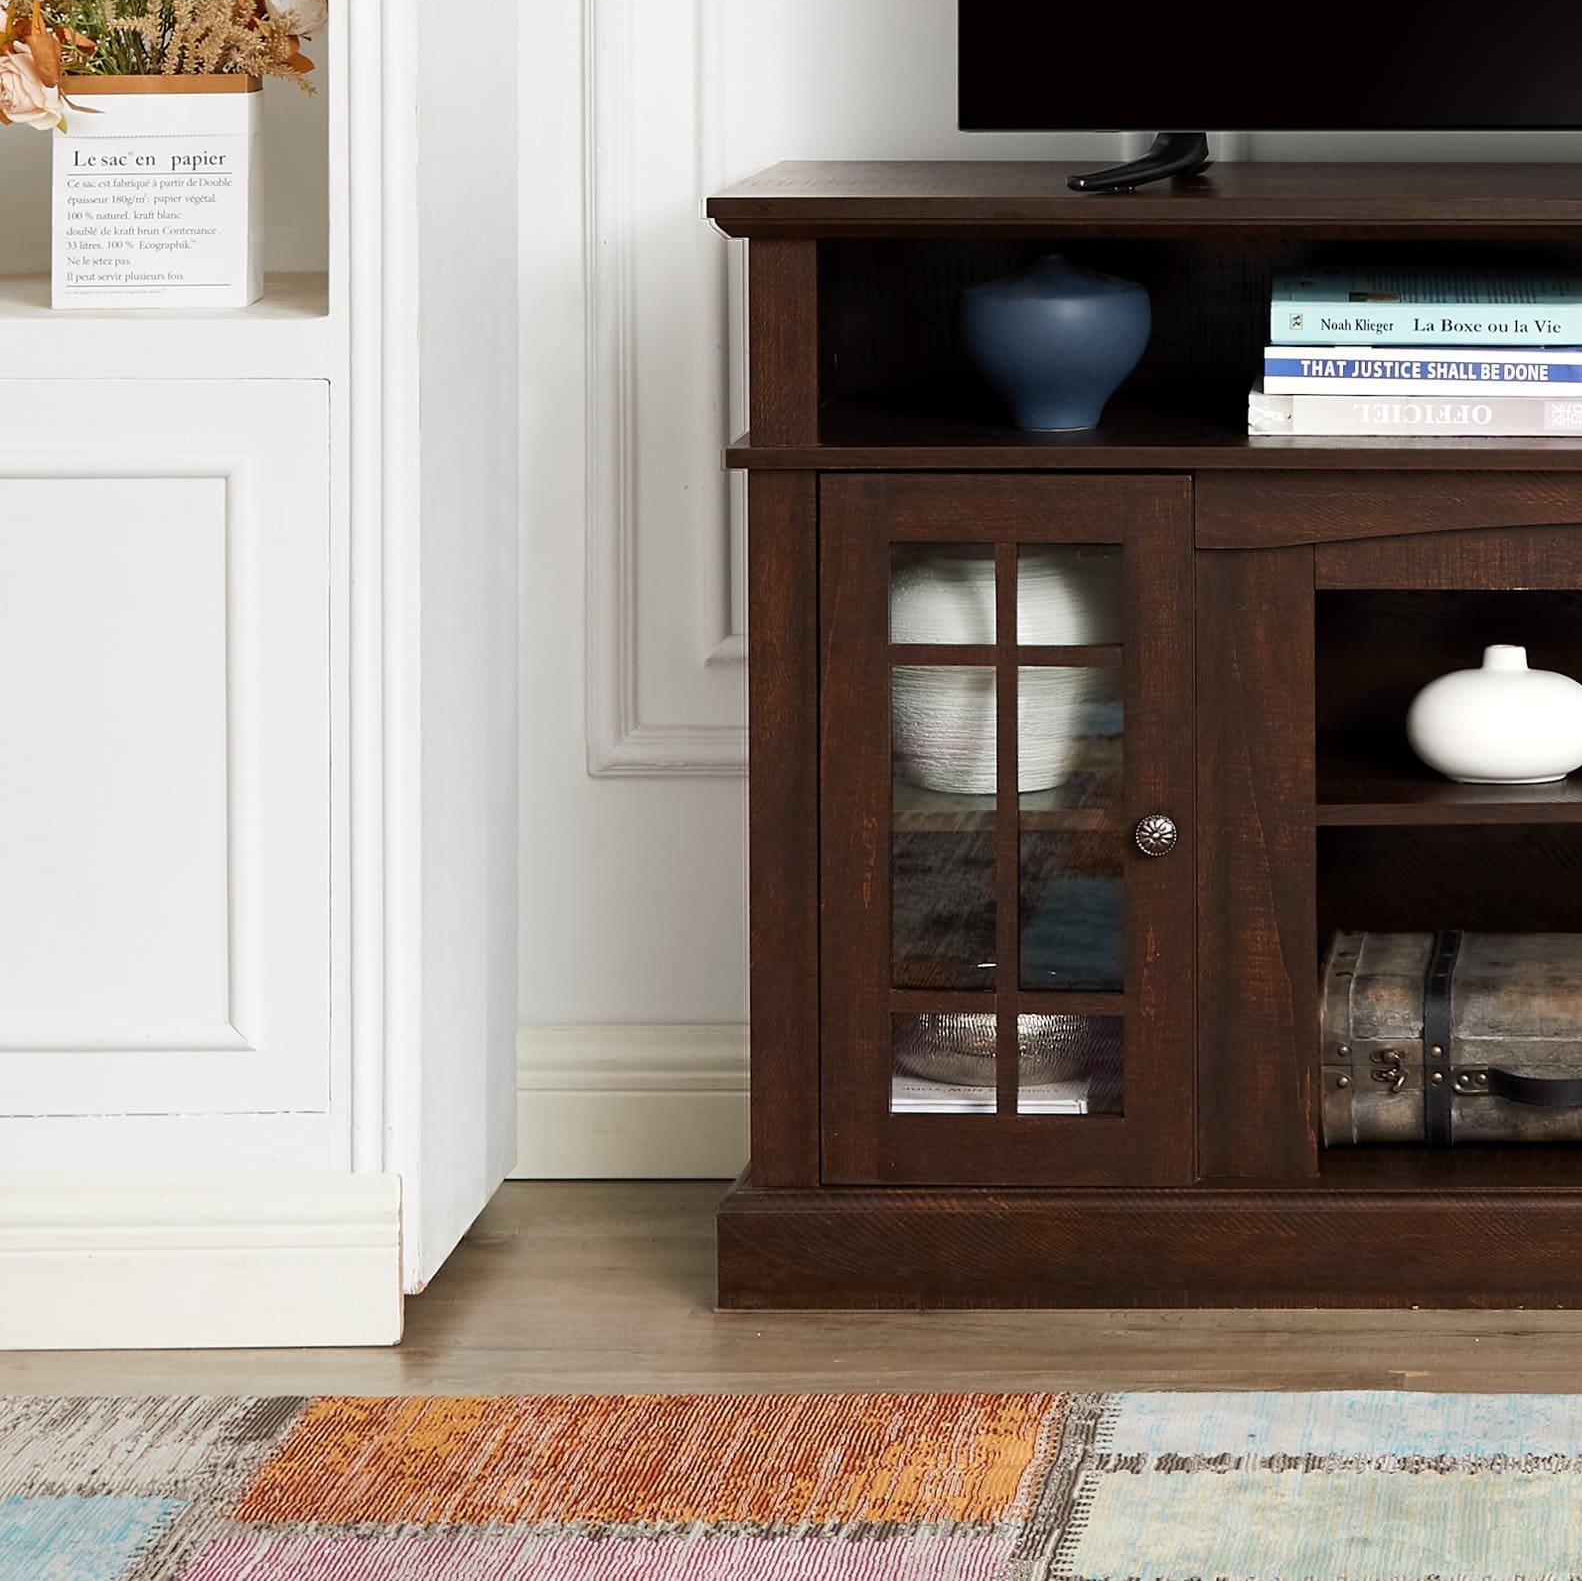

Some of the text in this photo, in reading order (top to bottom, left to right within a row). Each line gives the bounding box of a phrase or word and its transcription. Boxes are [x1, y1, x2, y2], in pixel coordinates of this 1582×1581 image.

[73, 150, 97, 167] Le
[135, 154, 156, 166] en
[171, 151, 226, 170] papier
[67, 180, 80, 188] Ce
[98, 179, 110, 188] est
[112, 178, 150, 190] fabriqué
[159, 178, 185, 189] partir
[186, 178, 198, 187] de
[199, 178, 232, 187] Double
[153, 195, 182, 206] papier
[67, 212, 83, 220] 100
[85, 212, 94, 220] %
[133, 211, 155, 220] kraft
[157, 211, 182, 220] blanc
[100, 227, 112, 235] de
[113, 226, 135, 236] kraft
[137, 226, 159, 235] brun
[162, 226, 217, 235] Contenance
[67, 241, 78, 249] 33
[107, 241, 123, 249] 100
[67, 257, 80, 265] Ne
[82, 257, 91, 265] le
[92, 257, 113, 267] jetez
[75, 273, 96, 283] peut
[97, 272, 123, 281] servir
[124, 271, 166, 282] plusieurs
[1321, 318, 1562, 334] Noah Klieger La Boxe ou la Vie
[1300, 359, 1549, 381] THAT JUSTICE SHALL BE DONE
